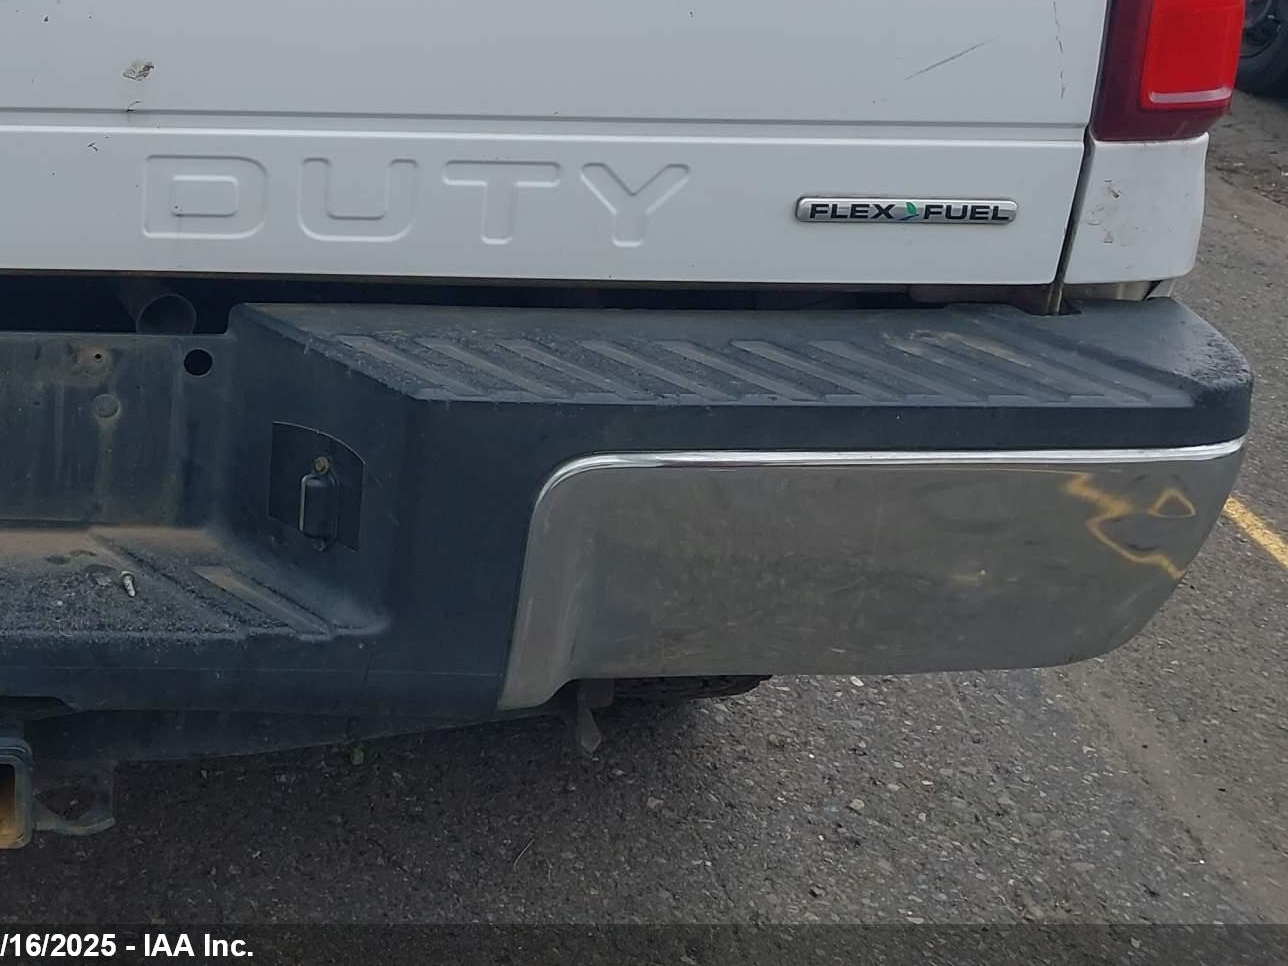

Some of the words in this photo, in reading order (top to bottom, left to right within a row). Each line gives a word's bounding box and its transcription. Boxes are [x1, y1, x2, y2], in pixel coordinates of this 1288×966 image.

[143, 154, 691, 247] DUTY
[809, 203, 895, 219] FLEX
[923, 204, 1009, 221] FUEL
